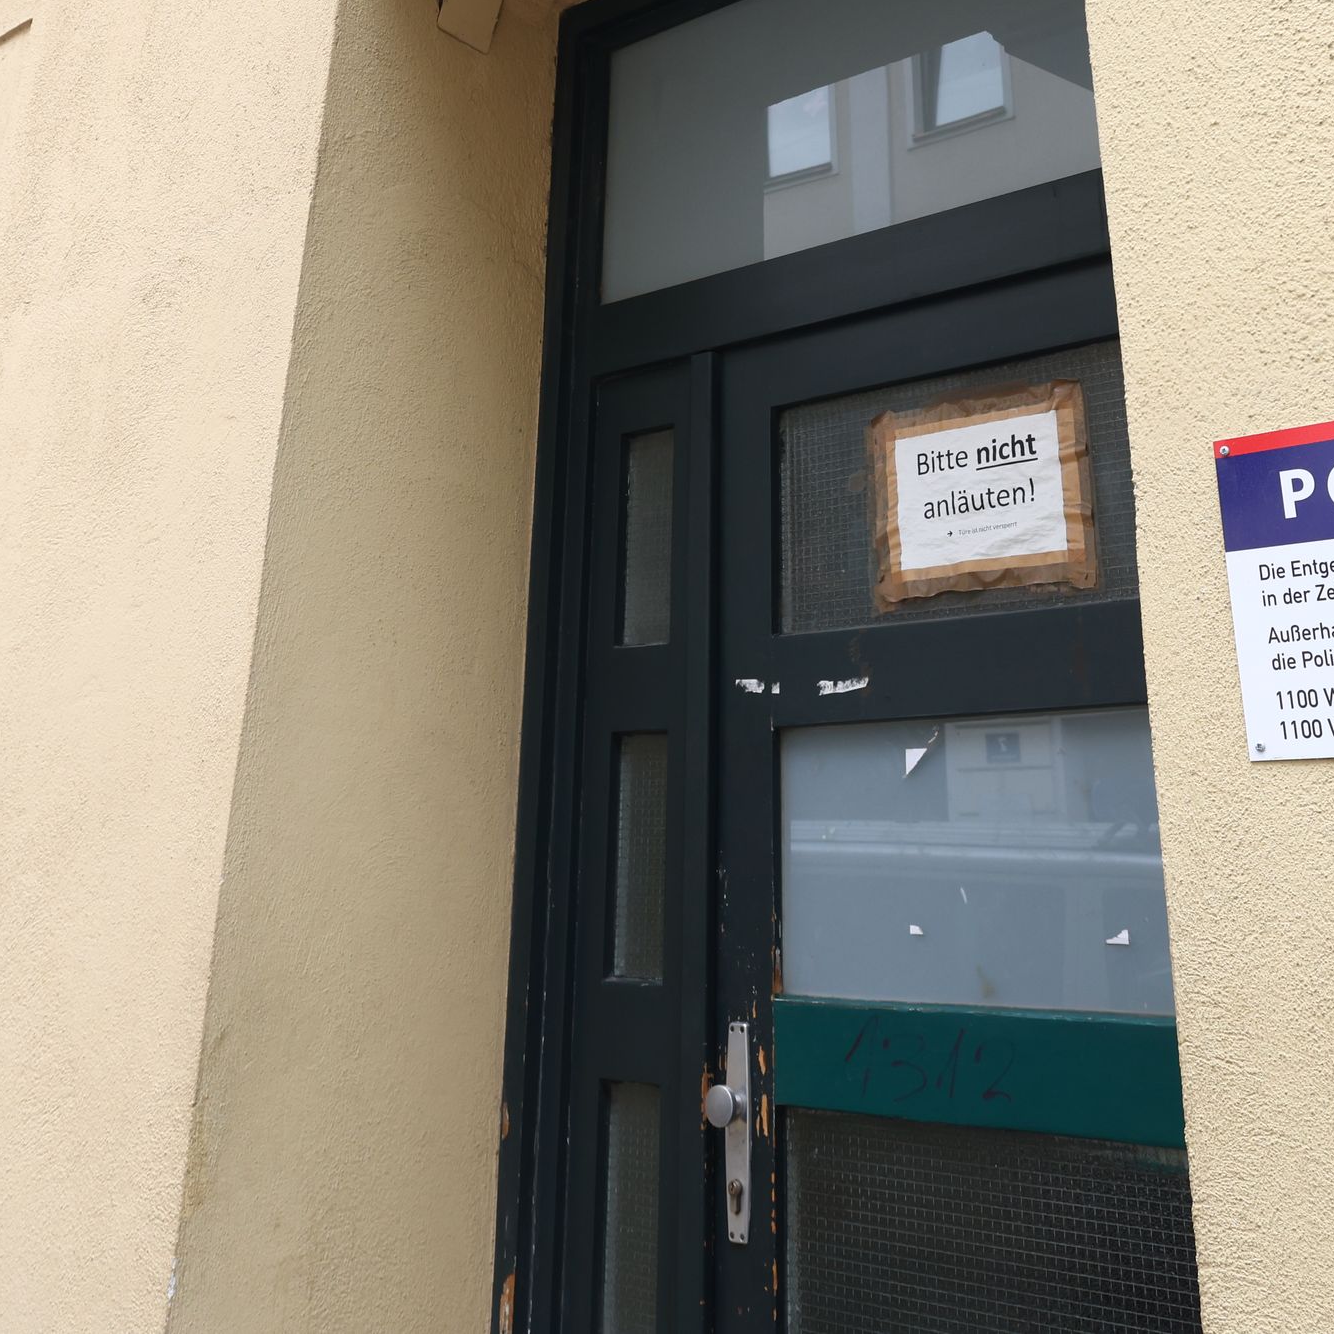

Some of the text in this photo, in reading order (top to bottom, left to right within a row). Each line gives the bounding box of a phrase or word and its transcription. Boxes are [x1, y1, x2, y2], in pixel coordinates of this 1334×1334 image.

[917, 433, 1037, 476] Bitte nicht
[923, 477, 1035, 520] anläuten!
[1258, 562, 1286, 581] Die
[1261, 590, 1278, 607] in
[1282, 587, 1311, 605] der
[1271, 652, 1297, 671] die
[1276, 688, 1319, 710] 1100
[1279, 718, 1323, 740] 1100
